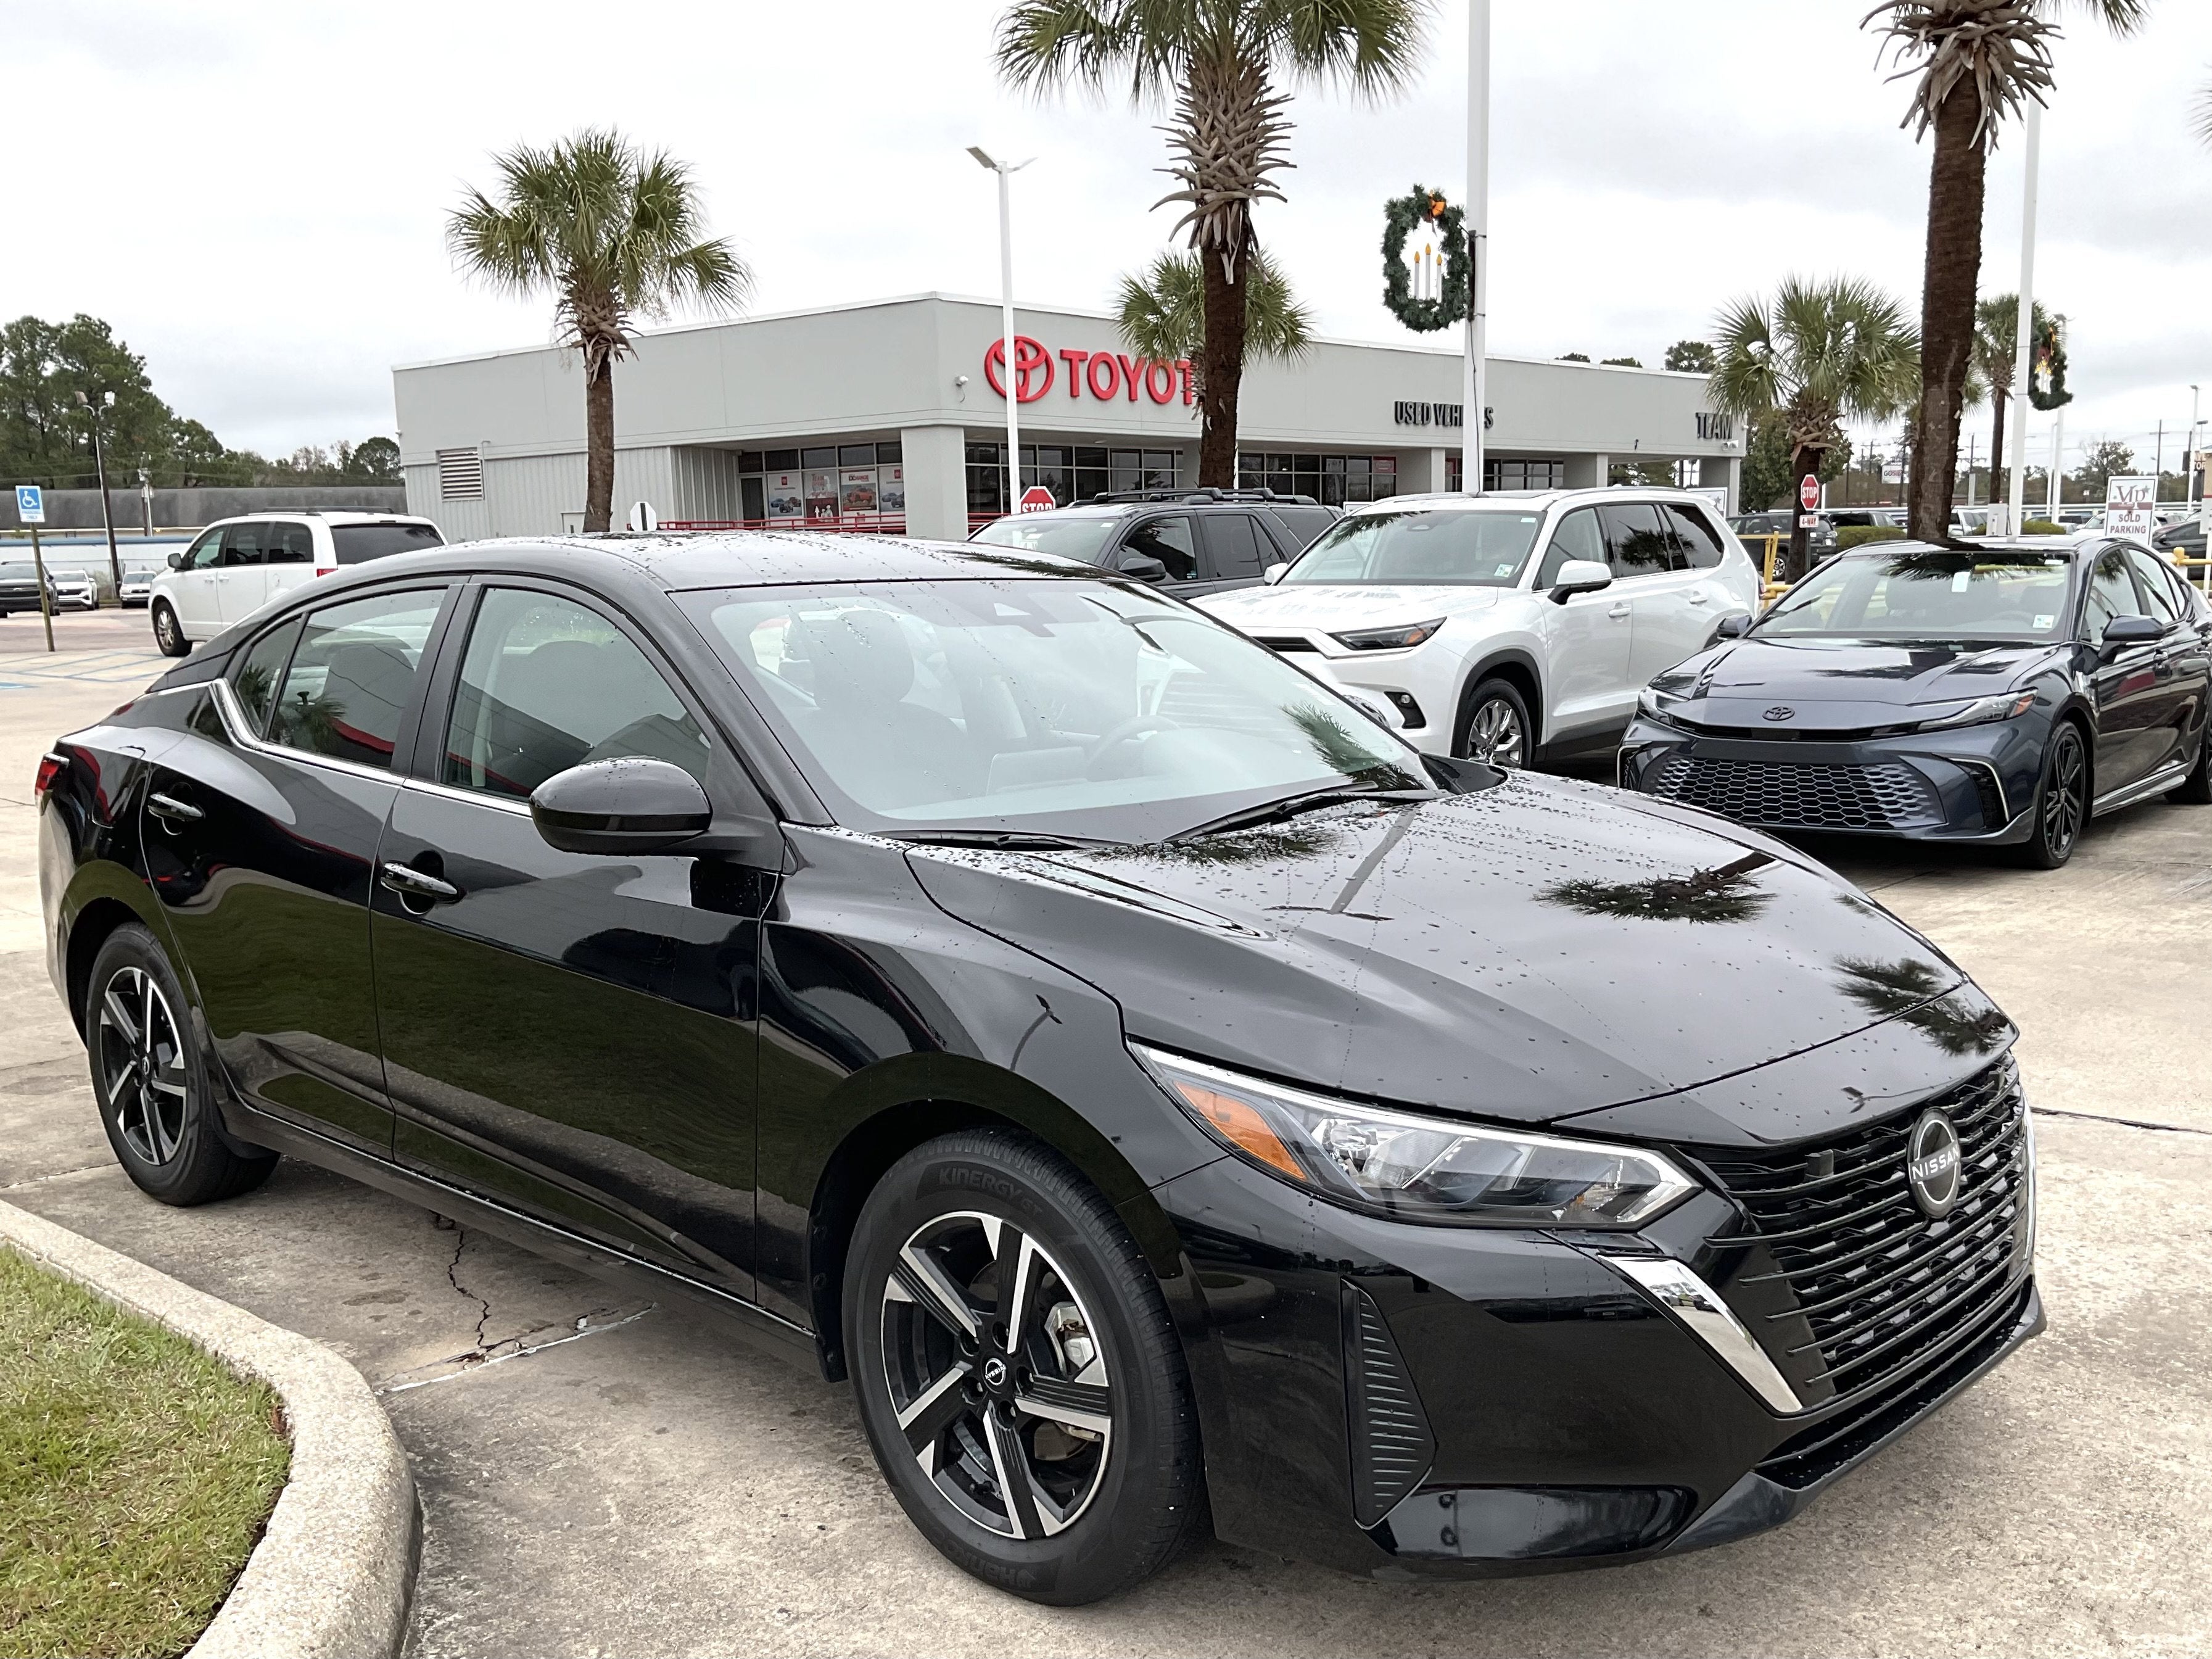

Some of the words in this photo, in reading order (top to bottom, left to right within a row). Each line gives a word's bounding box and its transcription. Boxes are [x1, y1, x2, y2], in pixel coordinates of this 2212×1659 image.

[1060, 349, 1194, 405] TOYOT
[1394, 401, 1432, 425] USED
[1433, 403, 1494, 429] VEHS
[1695, 412, 1732, 439] TEAM
[1802, 487, 1817, 499] STOP
[1801, 517, 1817, 526] 4-WAY
[2118, 514, 2140, 522] SOLD
[2110, 525, 2146, 534] PARKING
[1912, 1146, 1958, 1179] NISSAN
